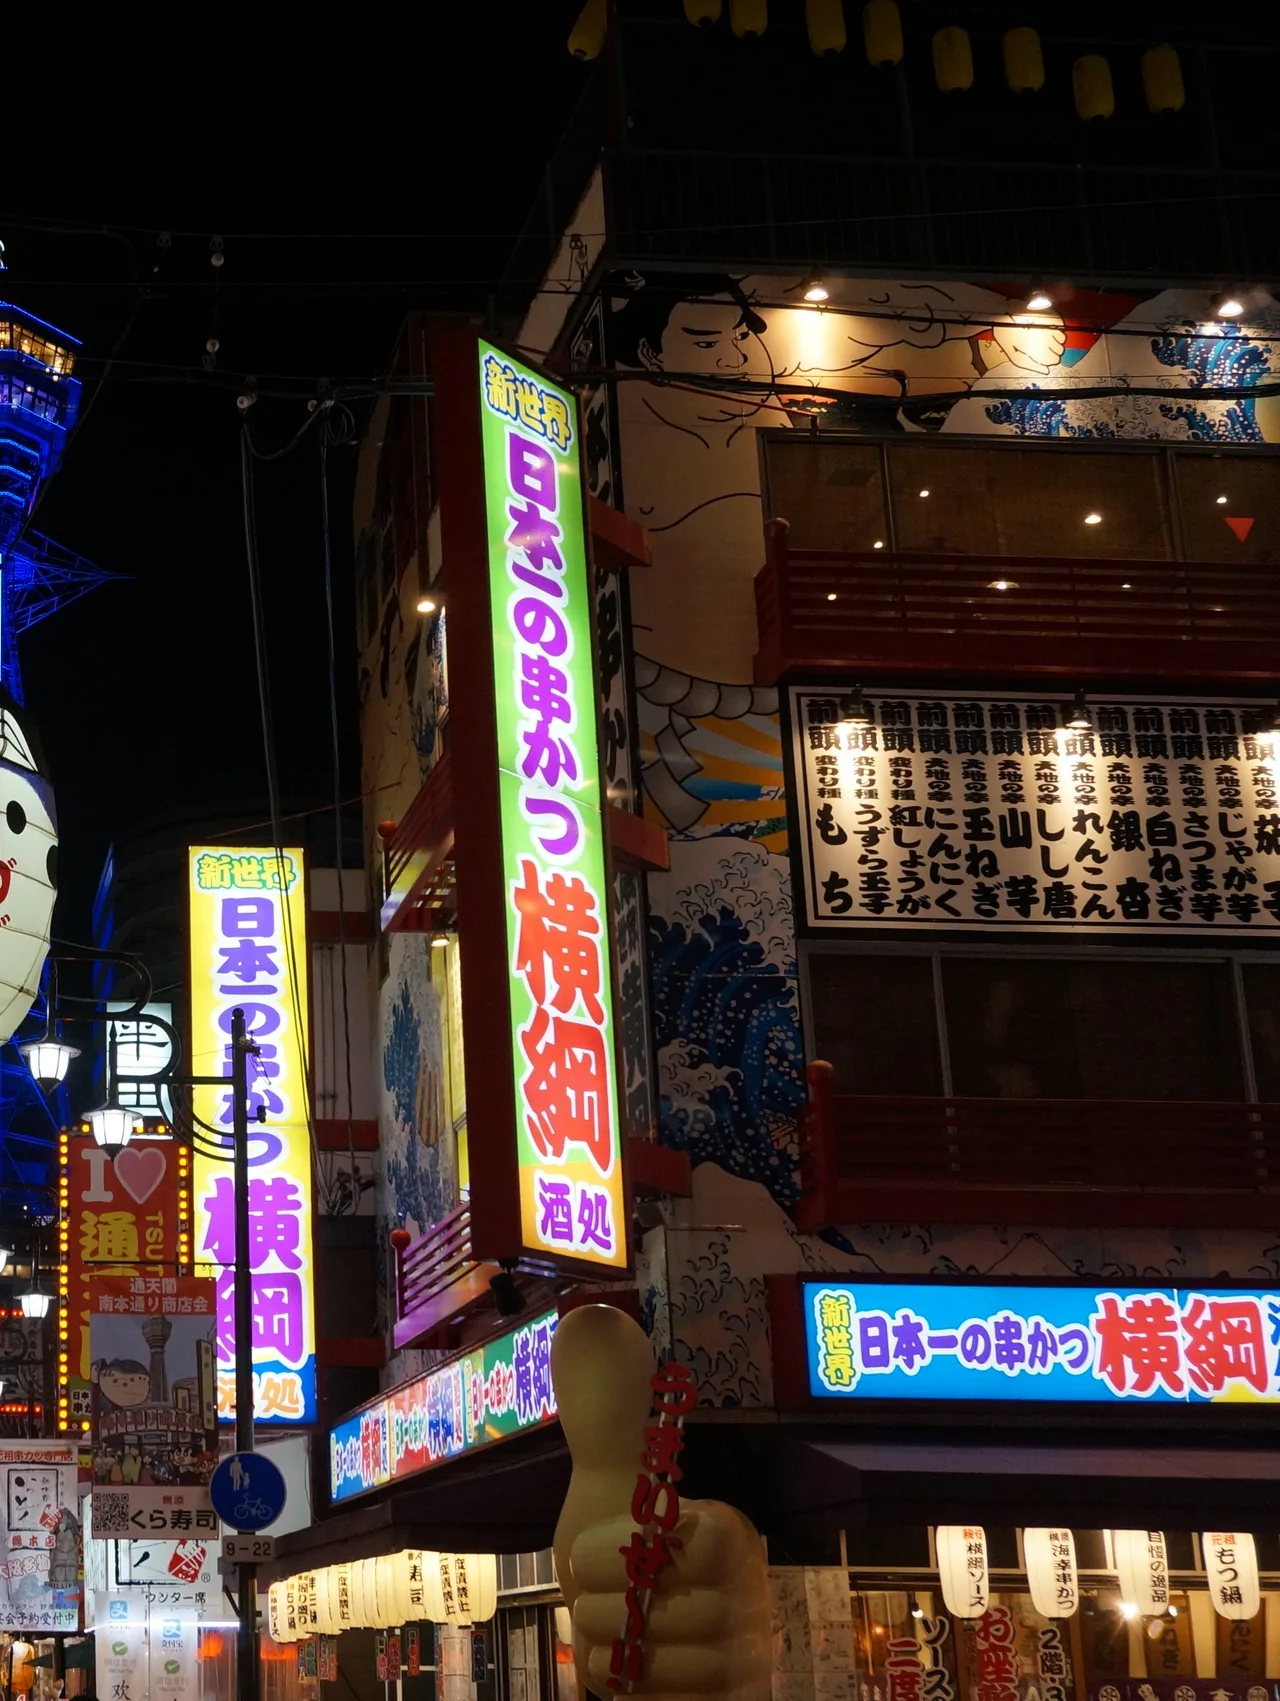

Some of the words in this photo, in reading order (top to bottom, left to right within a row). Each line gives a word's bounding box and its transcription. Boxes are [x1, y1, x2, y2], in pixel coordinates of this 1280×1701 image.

[484, 357, 572, 450] 新世界
[507, 432, 582, 857] 日本一の串かつ
[806, 699, 841, 750] 前頭
[879, 701, 915, 753] 前頭
[916, 701, 952, 755] 前頭
[952, 702, 988, 756] 前頭
[988, 703, 1025, 757] 前頭
[1025, 704, 1060, 757] 前頭
[1096, 706, 1133, 759] 前頭
[1132, 707, 1169, 760] 前頭
[1168, 708, 1205, 761] 前頭
[1204, 709, 1241, 762] 前頭
[925, 758, 952, 802] 大地の幸
[961, 759, 989, 803] 大地の幸
[998, 759, 1025, 804] 大地の幸
[1035, 760, 1061, 805] 大地の幸
[1072, 761, 1097, 805] 大地の幸
[1107, 762, 1134, 806] 大地の幸
[1143, 762, 1170, 807] 大地の幸
[1179, 763, 1206, 808] 大地の幸
[1214, 765, 1243, 809] 大地の幸
[1251, 766, 1279, 810] 大地の幸
[197, 855, 295, 890] 新世界
[816, 803, 853, 914] もち
[853, 804, 893, 915] うずら玉子
[889, 805, 931, 915] 紅しょうが
[925, 807, 964, 917] にんにく
[963, 807, 1004, 918] 玉ねぎ
[998, 808, 1039, 918] 山芋
[1036, 808, 1077, 919] しし唐
[1072, 809, 1115, 919] れんこん
[1107, 810, 1151, 920] 銀杏
[1146, 811, 1188, 921] 白ねぎ
[1182, 811, 1224, 922] さつま芋
[1218, 812, 1261, 923] じゃが芋
[511, 858, 614, 1175] 横綱
[538, 1178, 612, 1252] 酒処
[79, 1210, 140, 1277] 通
[98, 1296, 209, 1314] 南本通り商店会
[130, 1277, 177, 1294] 通天閣
[822, 1295, 856, 1386] 新世界
[858, 1313, 1090, 1371] 日本一の串かつ
[1096, 1296, 1269, 1394] 横綱
[128, 1510, 217, 1531] くら寿司
[1215, 1547, 1243, 1604] もつ鍋
[920, 1615, 954, 1701] ソース
